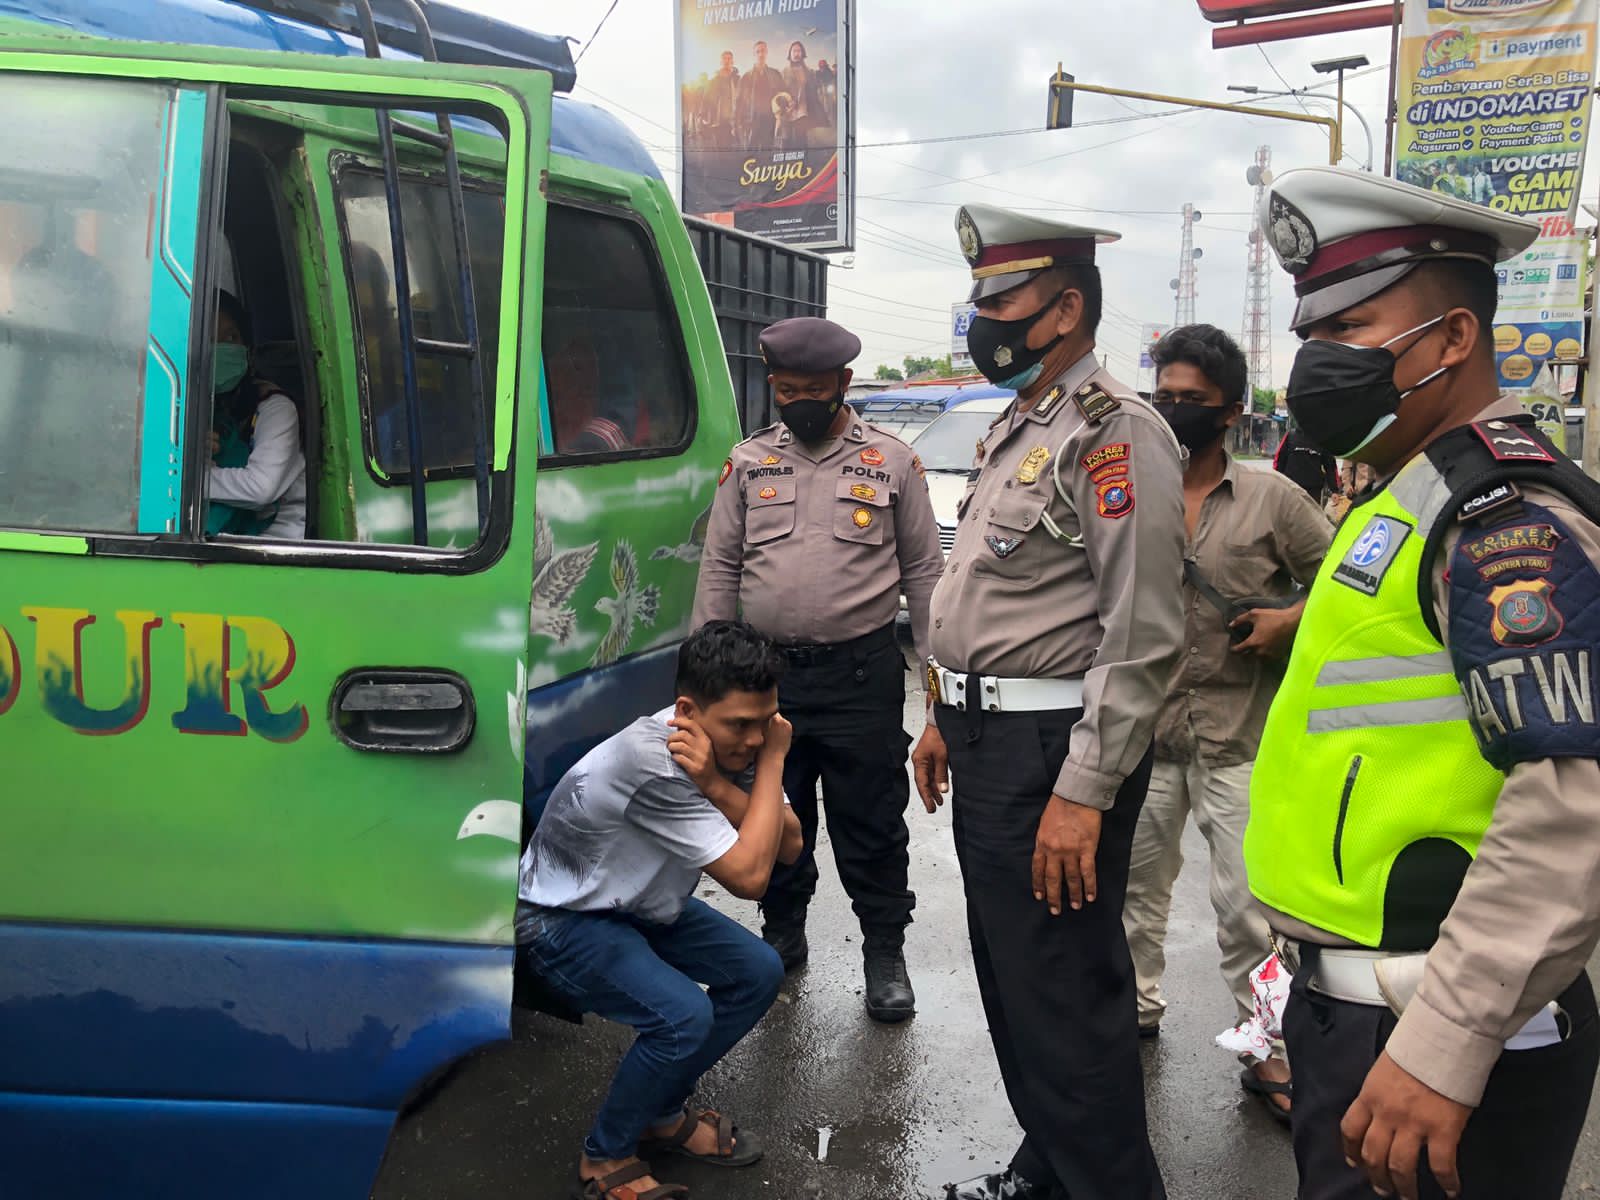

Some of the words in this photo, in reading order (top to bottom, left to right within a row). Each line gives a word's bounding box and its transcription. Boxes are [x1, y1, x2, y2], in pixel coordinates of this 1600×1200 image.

[704, 0, 773, 25] NYALAKAN
[1507, 34, 1582, 56] payment
[1412, 80, 1503, 95] Pembayaran
[1507, 73, 1553, 88] SerBa
[1557, 71, 1589, 83] Bisa
[1409, 102, 1430, 122] di
[1434, 88, 1588, 120] INDOMARET
[1418, 129, 1459, 141] Tagihan
[1481, 124, 1528, 136] Voucher
[1531, 121, 1563, 132] Game
[1409, 142, 1460, 154] Angsuran
[1481, 138, 1529, 149] Payment
[1533, 134, 1563, 145] Point
[740, 159, 812, 191] Surya
[1522, 403, 1561, 423] SA
[1086, 445, 1125, 464] POLRES
[842, 465, 891, 483] POLRI
[1463, 485, 1509, 511] POLISI
[1470, 528, 1553, 551] POLRES
[1483, 559, 1521, 577] SUMATERA
[1521, 559, 1548, 569] UTARA
[0, 606, 309, 744] UR
[1461, 651, 1595, 744] ATW
